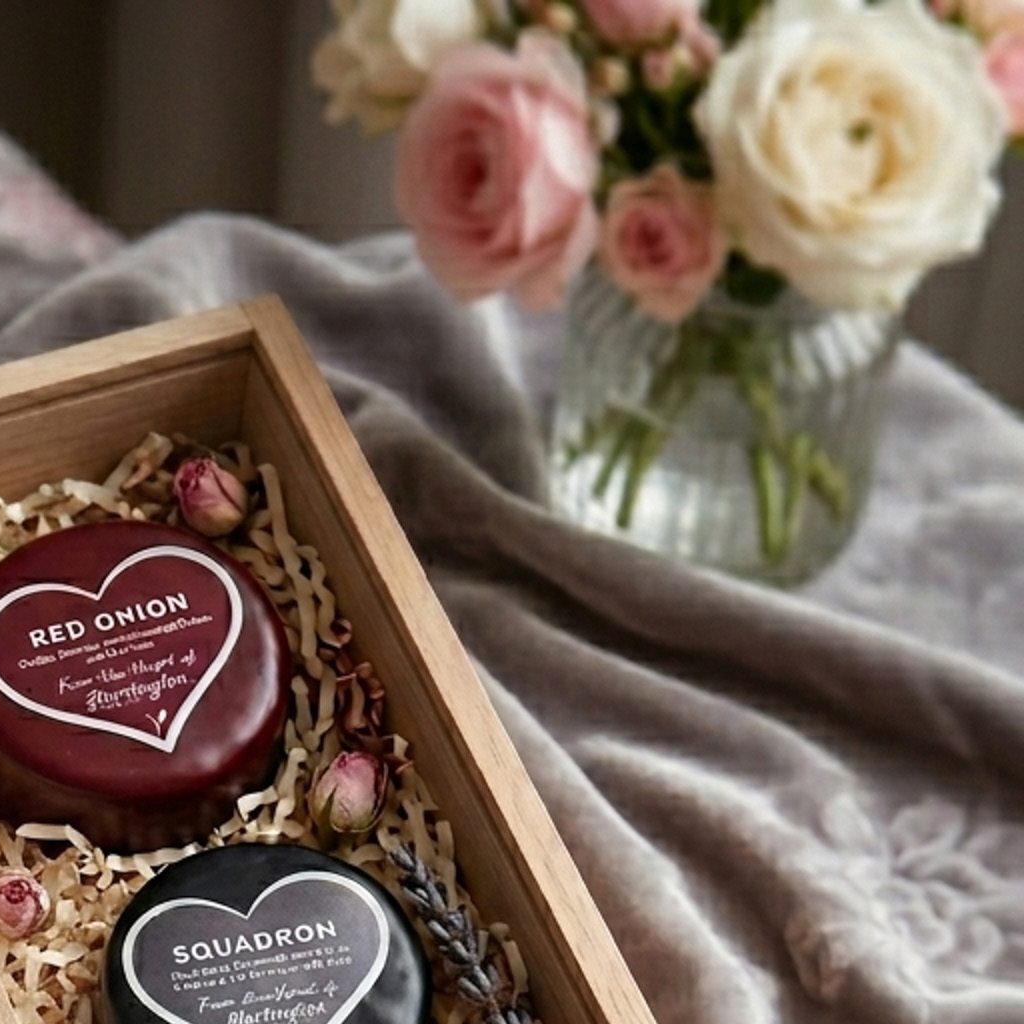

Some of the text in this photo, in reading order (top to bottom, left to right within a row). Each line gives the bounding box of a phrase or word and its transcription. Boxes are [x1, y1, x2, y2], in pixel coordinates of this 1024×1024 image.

[29, 620, 86, 648] RED
[94, 593, 189, 631] ONION
[173, 920, 337, 964] SQUADRON
